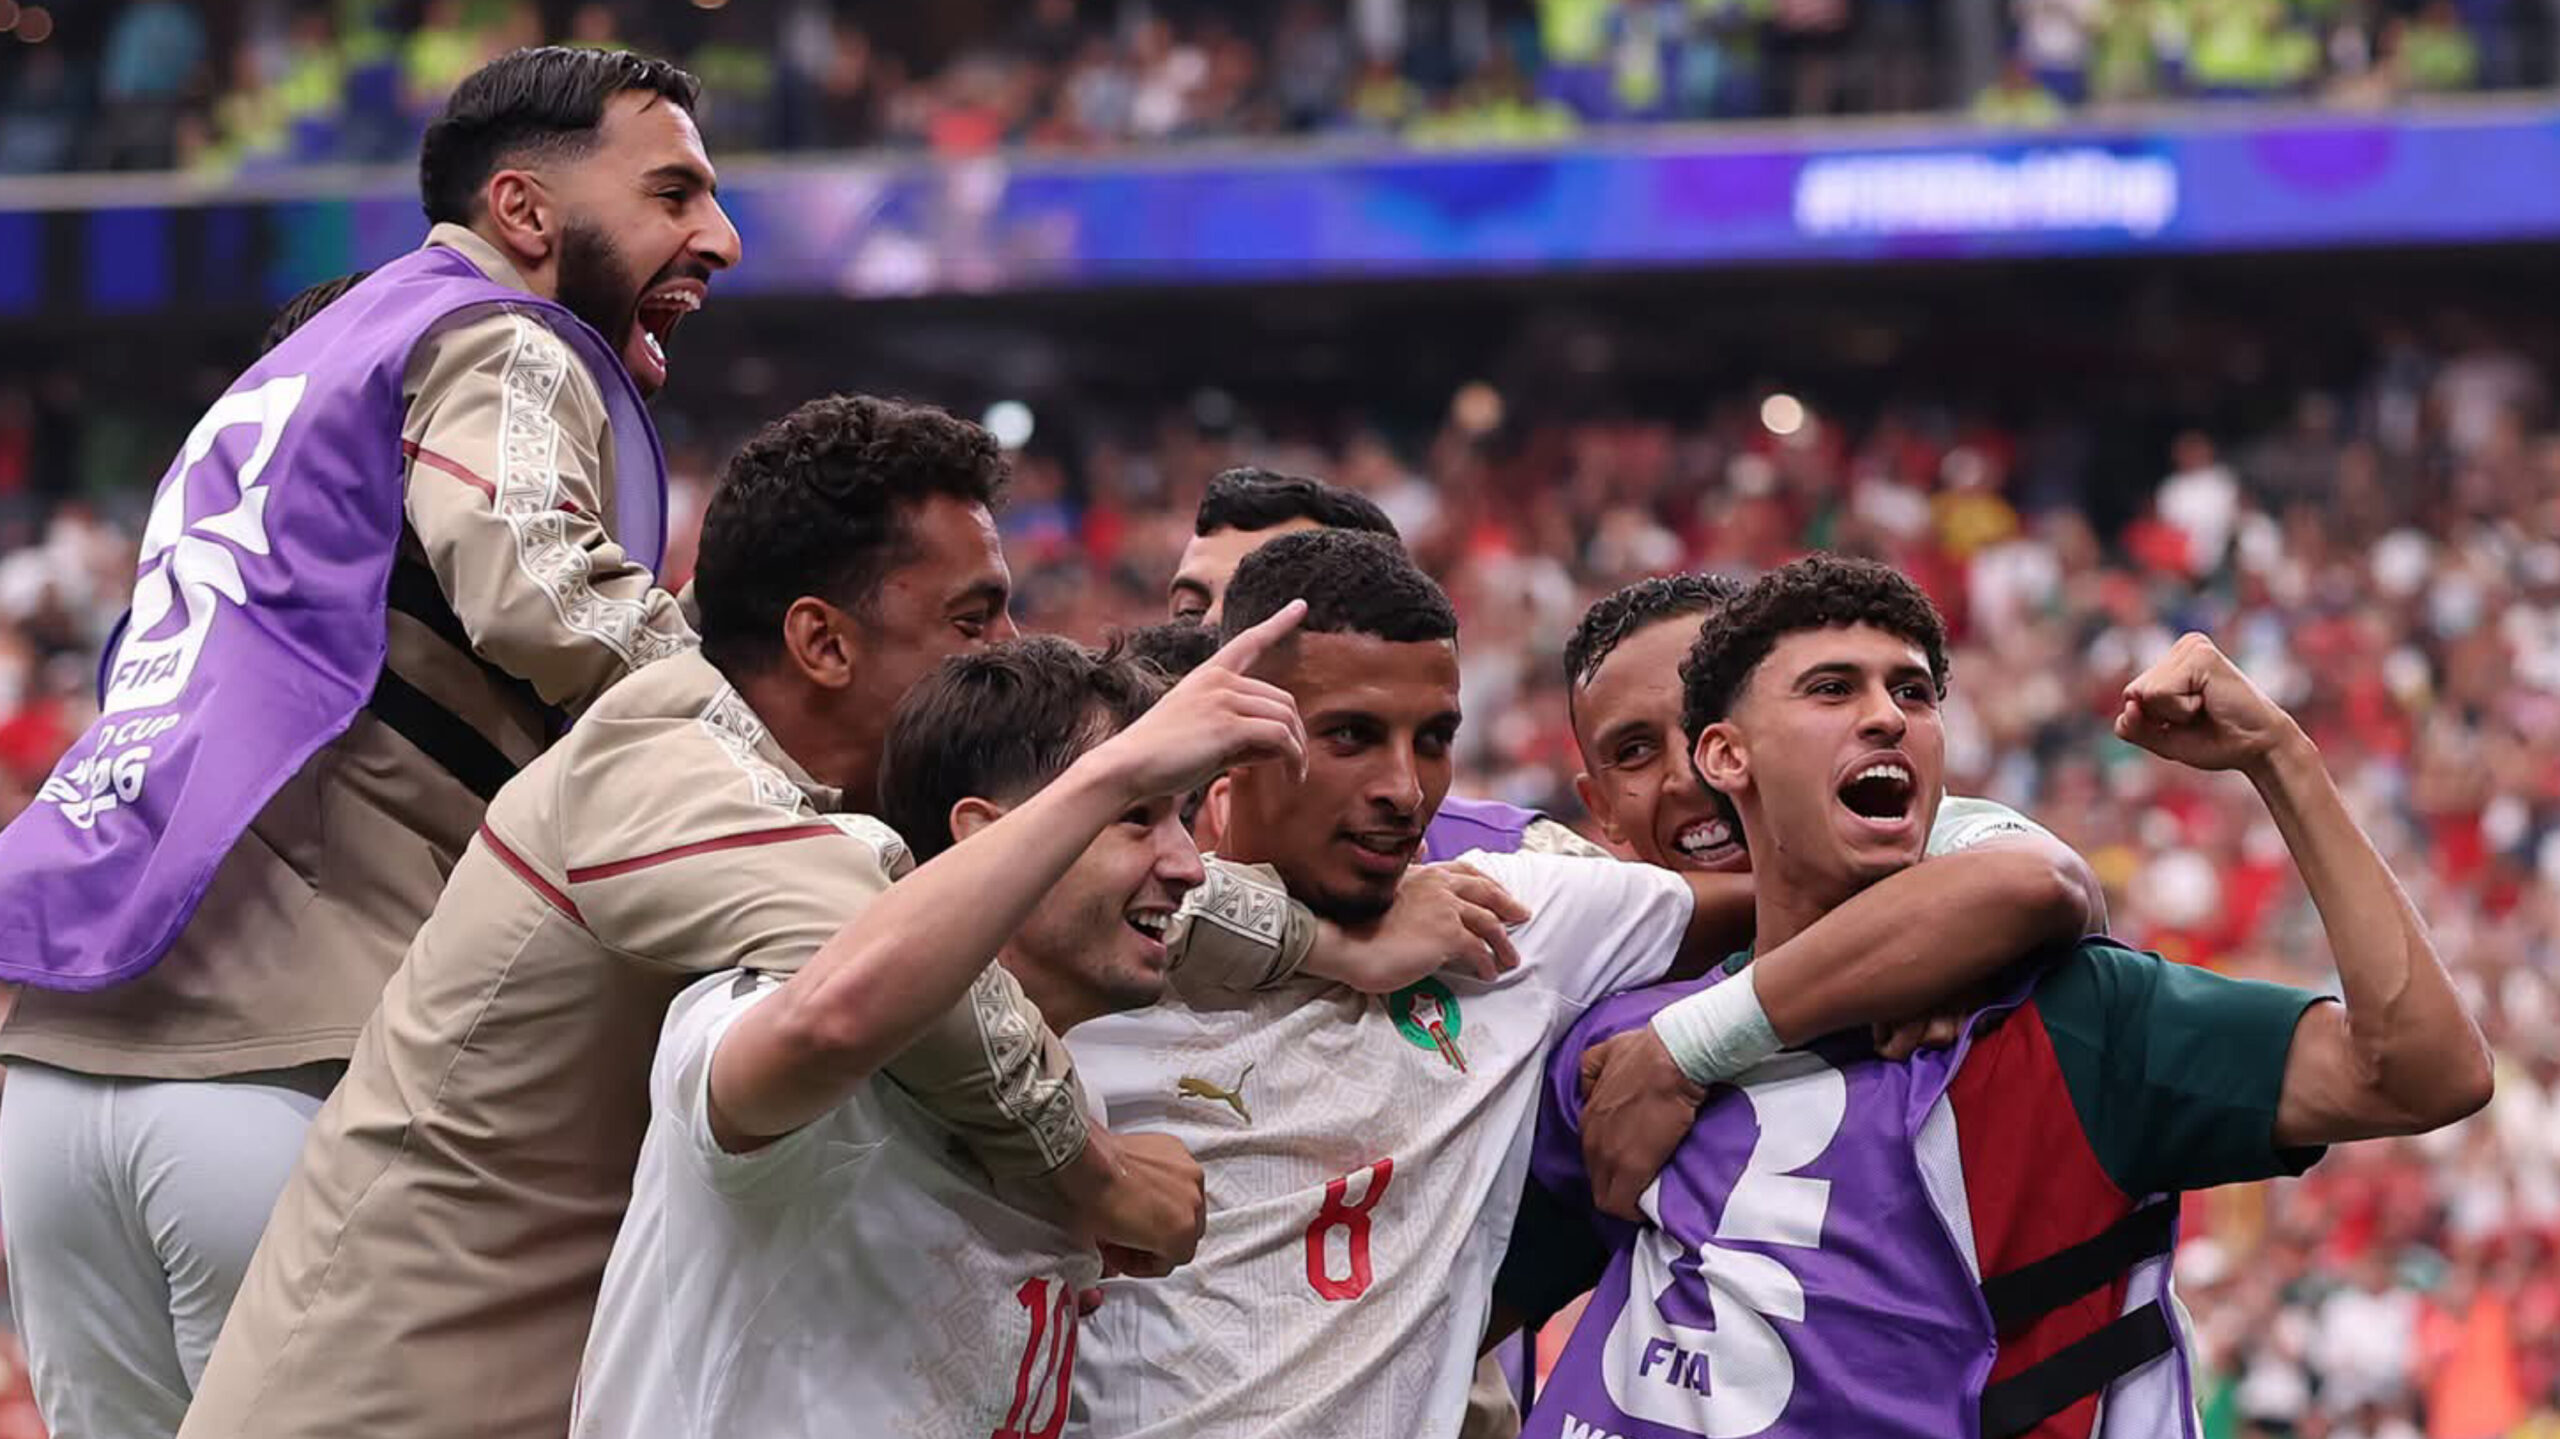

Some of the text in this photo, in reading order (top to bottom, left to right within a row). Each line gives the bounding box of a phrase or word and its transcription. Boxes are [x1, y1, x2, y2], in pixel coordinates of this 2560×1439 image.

[111, 648, 182, 690] FIFA
[114, 712, 181, 746] CUP
[1306, 1157, 1394, 1301] 8
[990, 1276, 1078, 1439] 10
